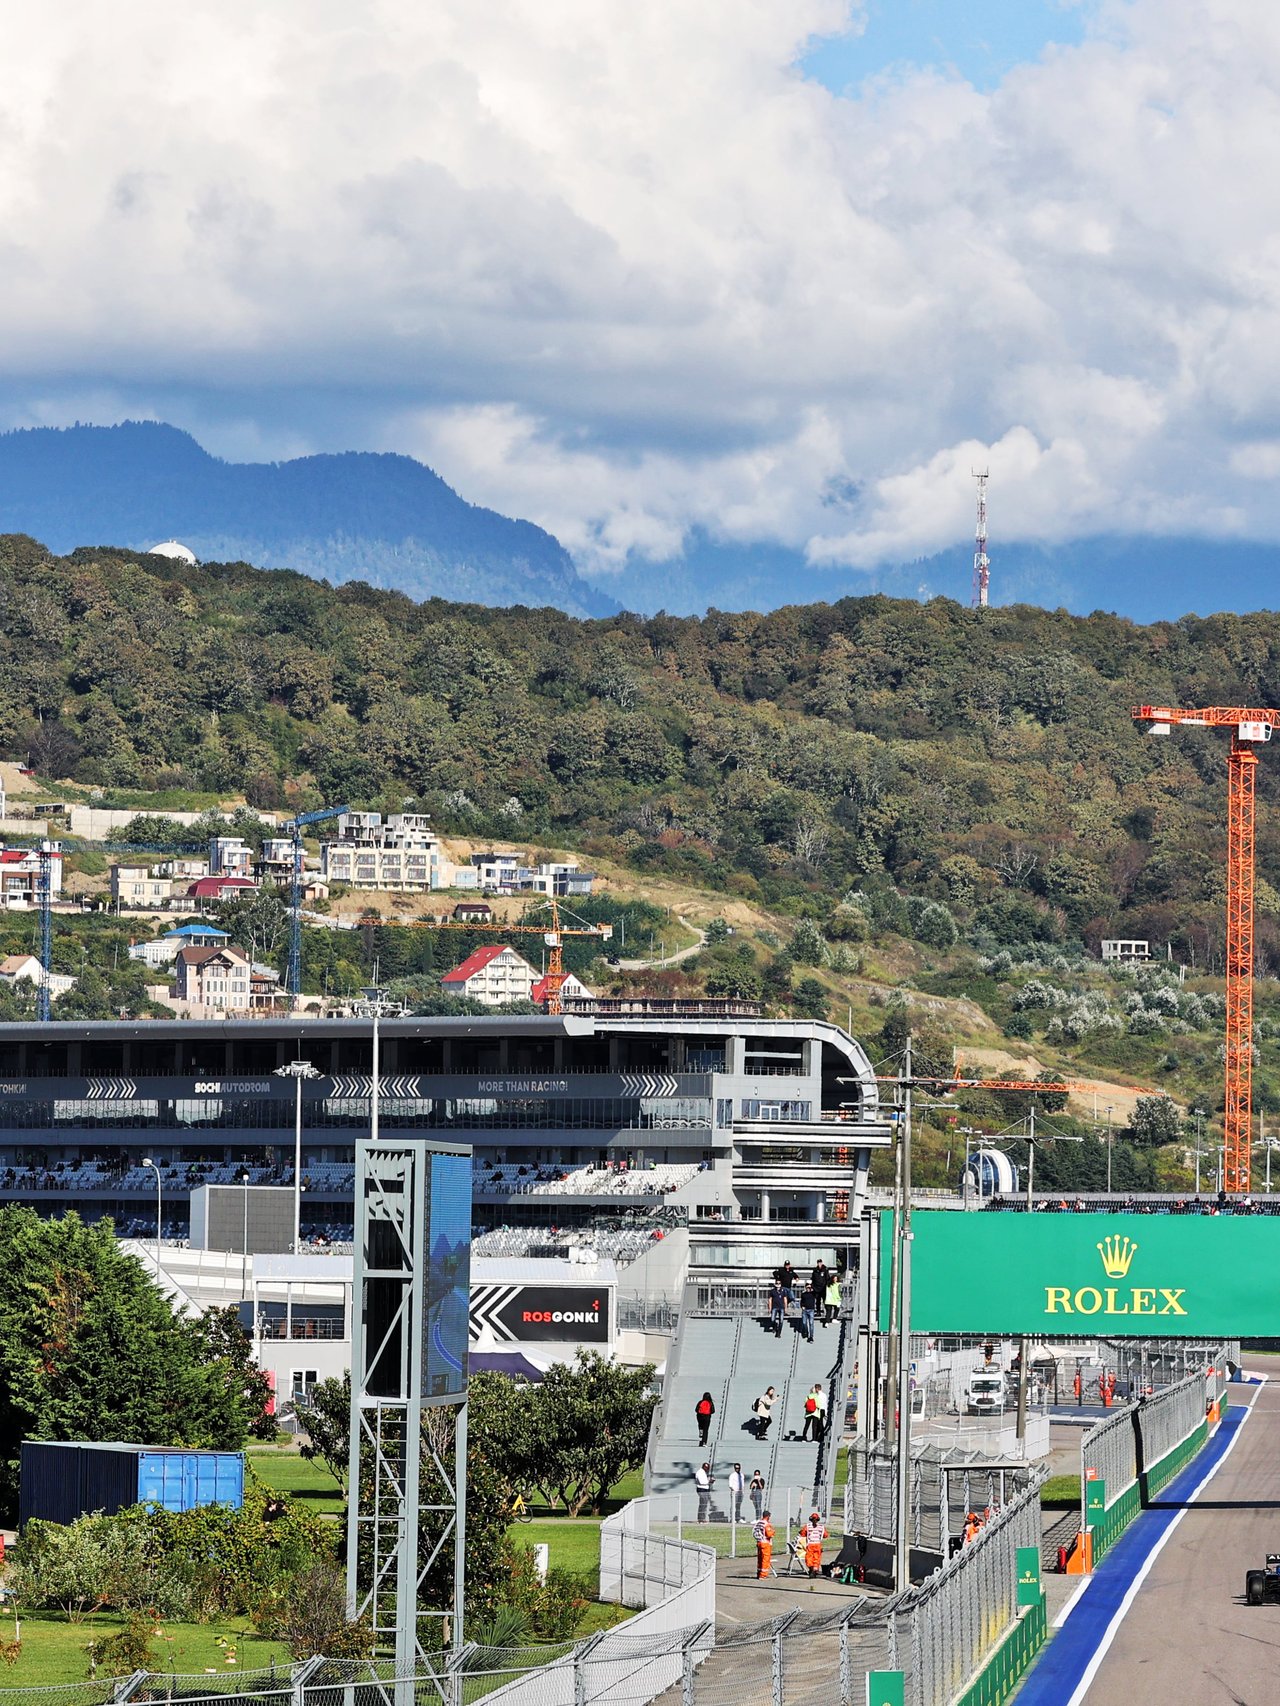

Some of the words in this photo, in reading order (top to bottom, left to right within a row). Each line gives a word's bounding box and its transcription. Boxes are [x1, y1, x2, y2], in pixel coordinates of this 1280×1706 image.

[478, 1081, 504, 1092] MORE
[506, 1081, 530, 1092] THAN
[531, 1081, 568, 1092] RACING!
[1044, 1286, 1188, 1315] ROLEX
[522, 1309, 599, 1323] ROSGONKI
